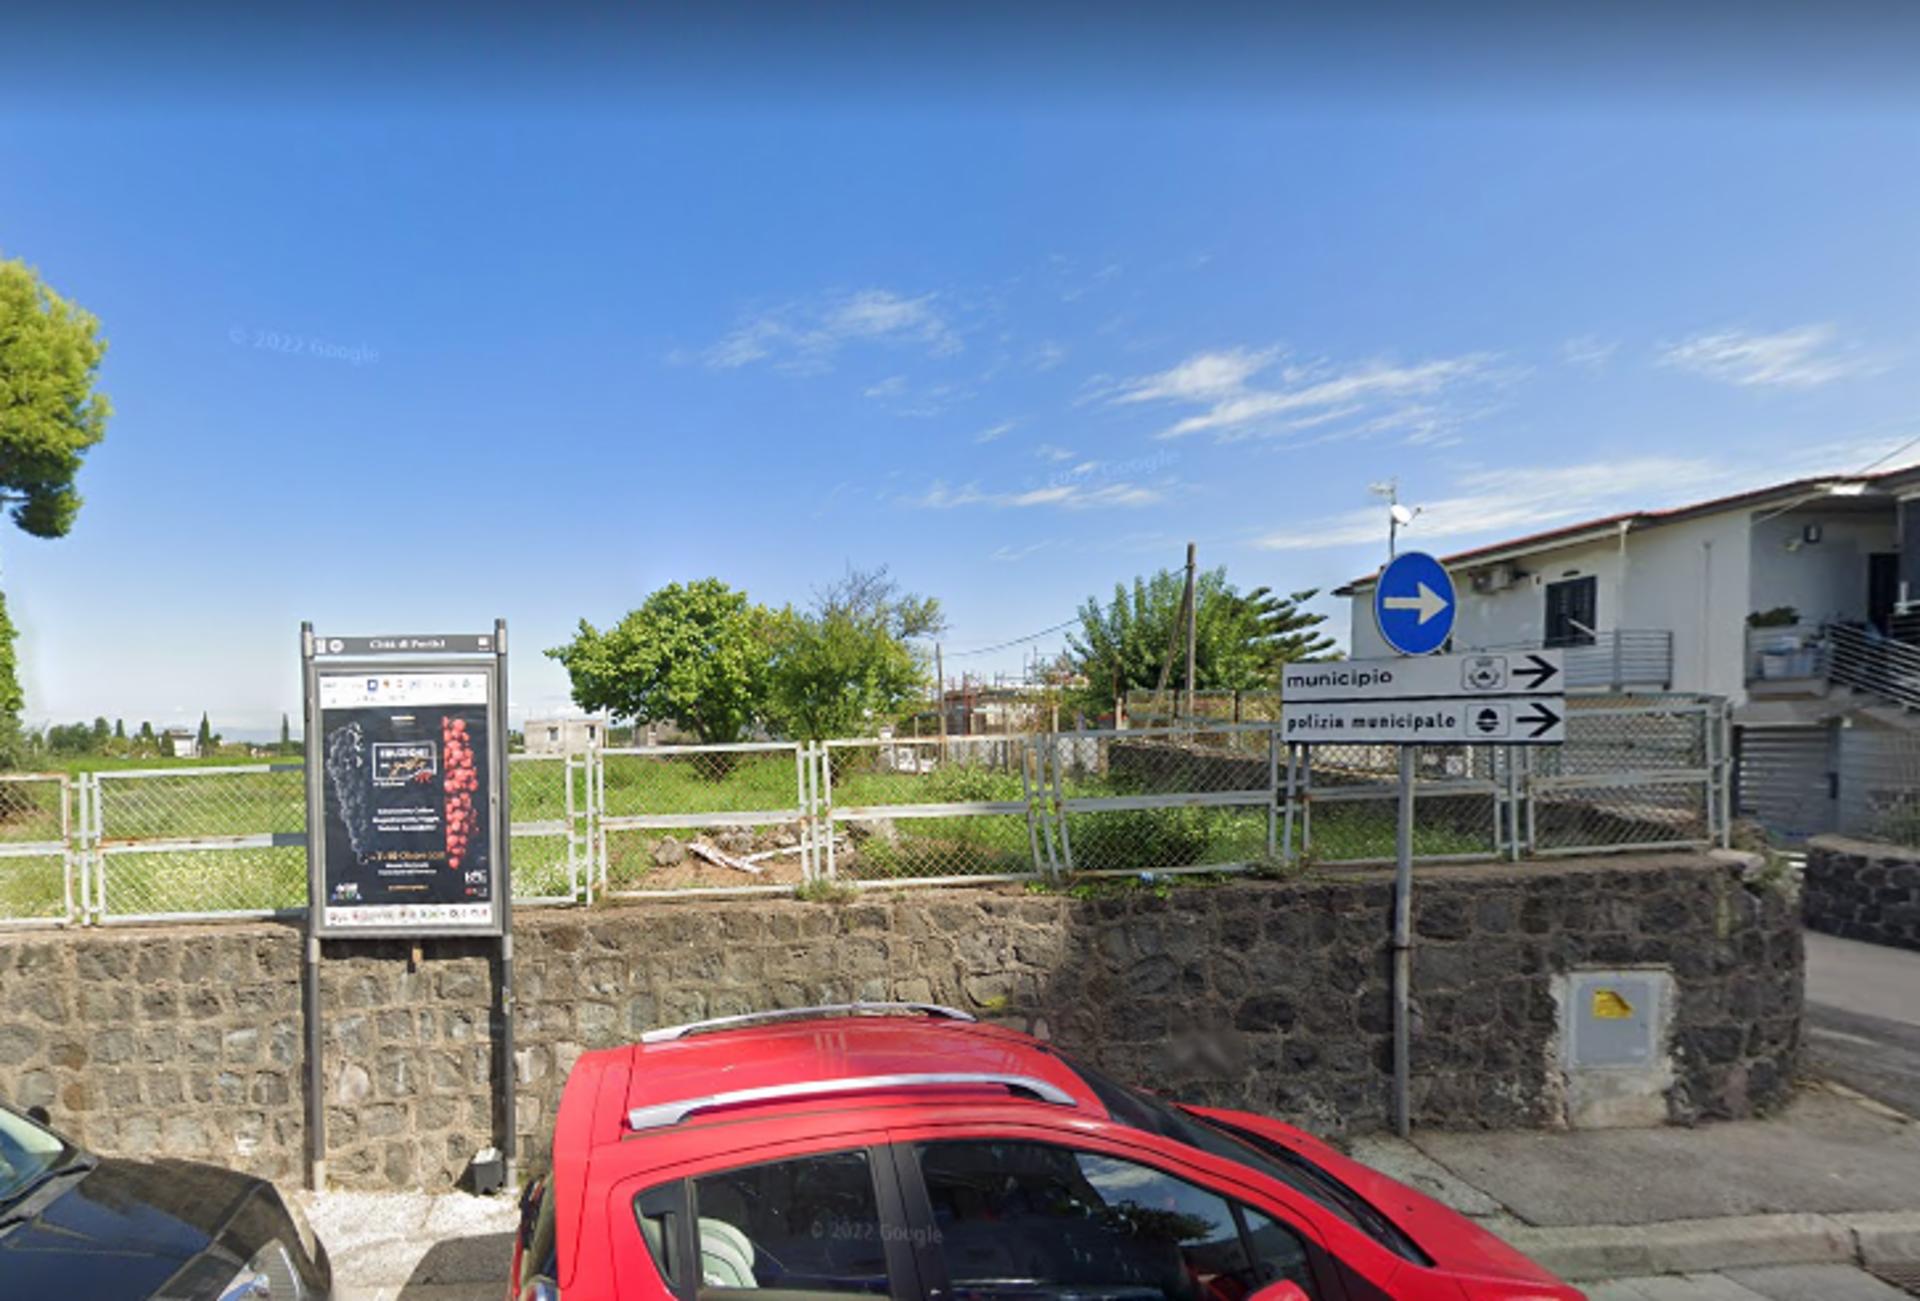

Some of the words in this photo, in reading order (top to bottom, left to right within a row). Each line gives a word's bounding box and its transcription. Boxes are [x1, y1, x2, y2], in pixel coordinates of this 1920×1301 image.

[1287, 668, 1393, 688] municipio
[1287, 713, 1344, 733] polizia
[1351, 712, 1456, 732] municipale
